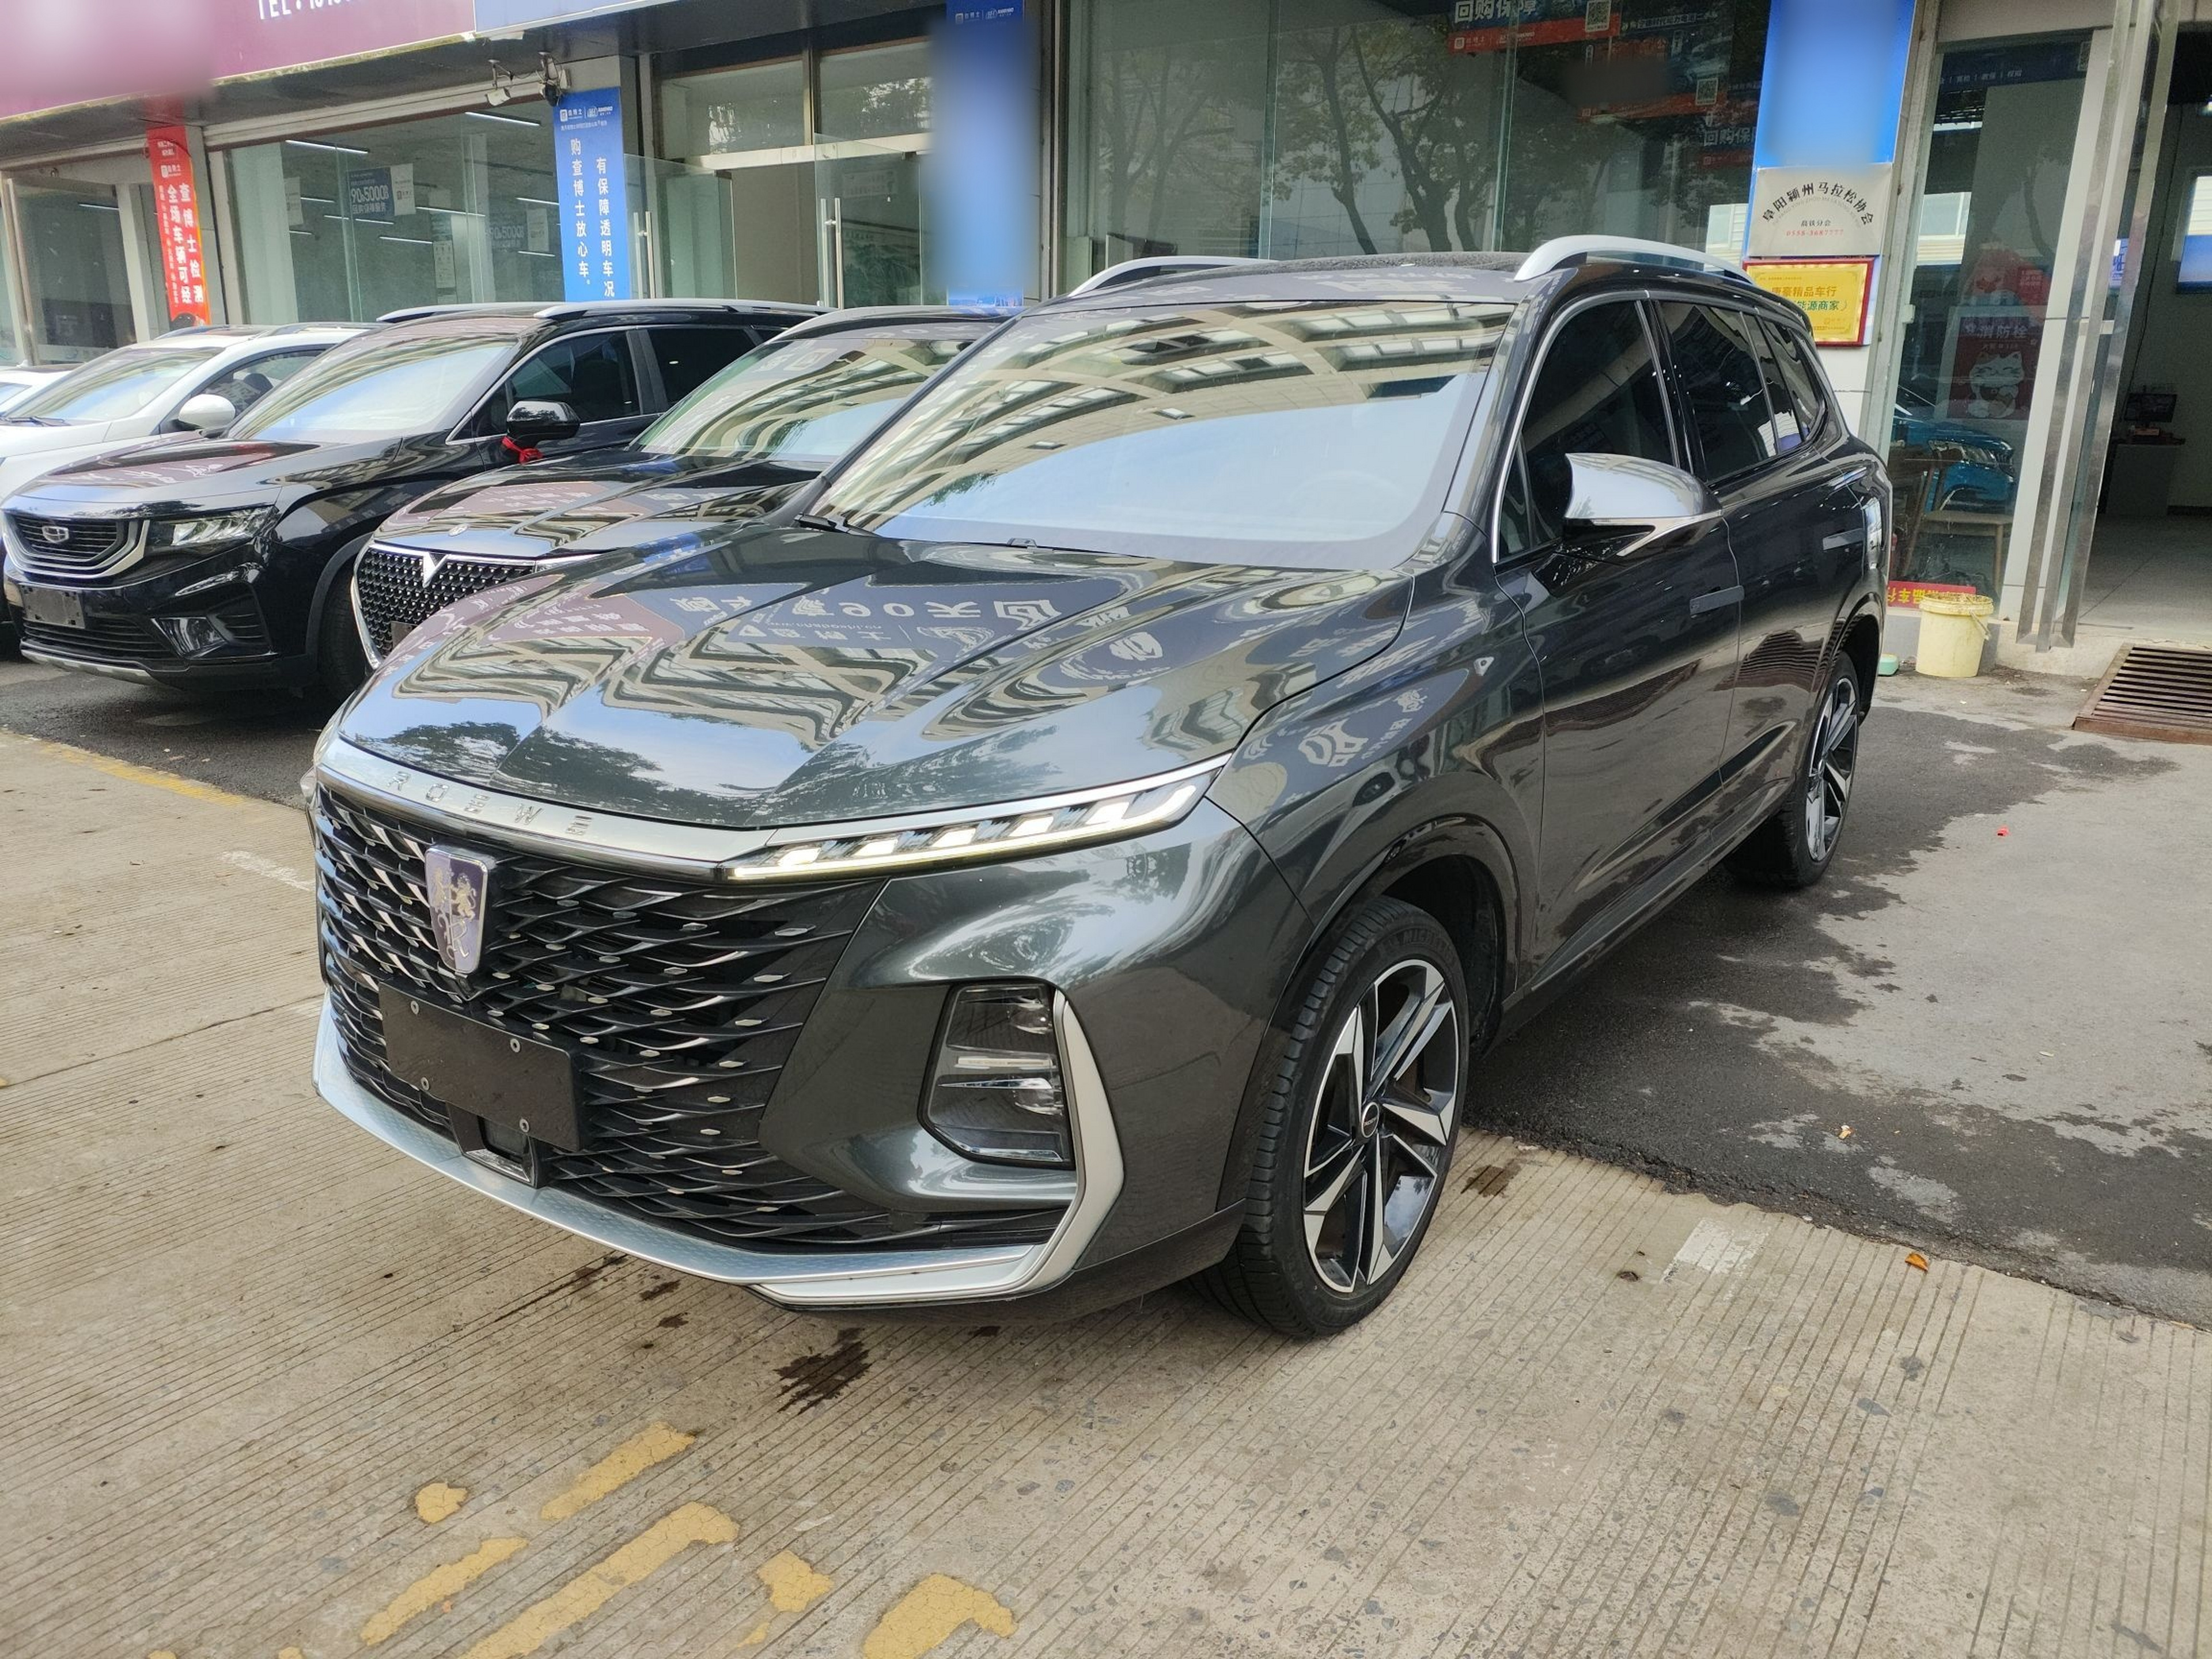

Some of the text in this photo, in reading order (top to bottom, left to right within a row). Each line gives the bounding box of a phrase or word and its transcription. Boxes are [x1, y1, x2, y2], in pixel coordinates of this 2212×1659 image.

[168, 184, 192, 304] 全场车辆可经
[596, 157, 615, 298] 有保障透明车况
[386, 770, 594, 835] ROEWE
